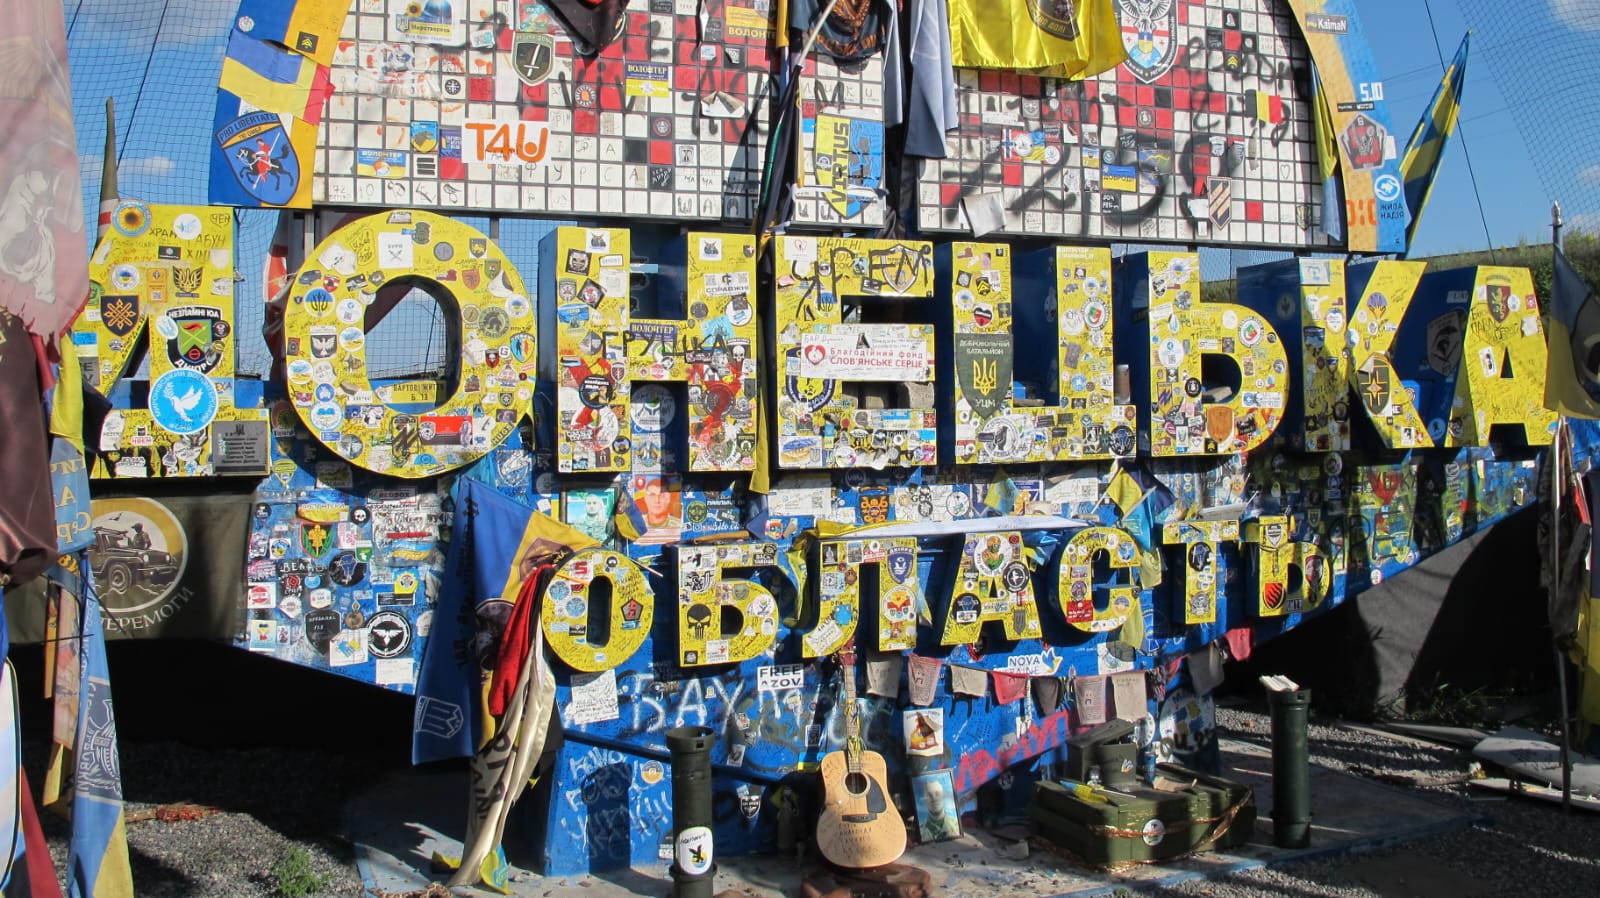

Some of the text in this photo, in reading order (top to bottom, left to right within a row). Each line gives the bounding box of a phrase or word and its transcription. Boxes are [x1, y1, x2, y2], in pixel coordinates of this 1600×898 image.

[1318, 18, 1346, 32] KaimaN
[729, 27, 776, 40] ВОЛОНТЕ
[234, 113, 276, 135] LIBERTATE
[465, 122, 549, 163] T4U
[832, 122, 849, 202] VIRTUS
[76, 203, 1560, 480] ДОНЕЦЬКА
[895, 359, 923, 368] СЕРЦЕ
[541, 515, 1332, 673] ОБЛАСТЬ
[1009, 656, 1040, 666] NOVA
[759, 665, 802, 679] FREE
[760, 677, 801, 688] AZOV
